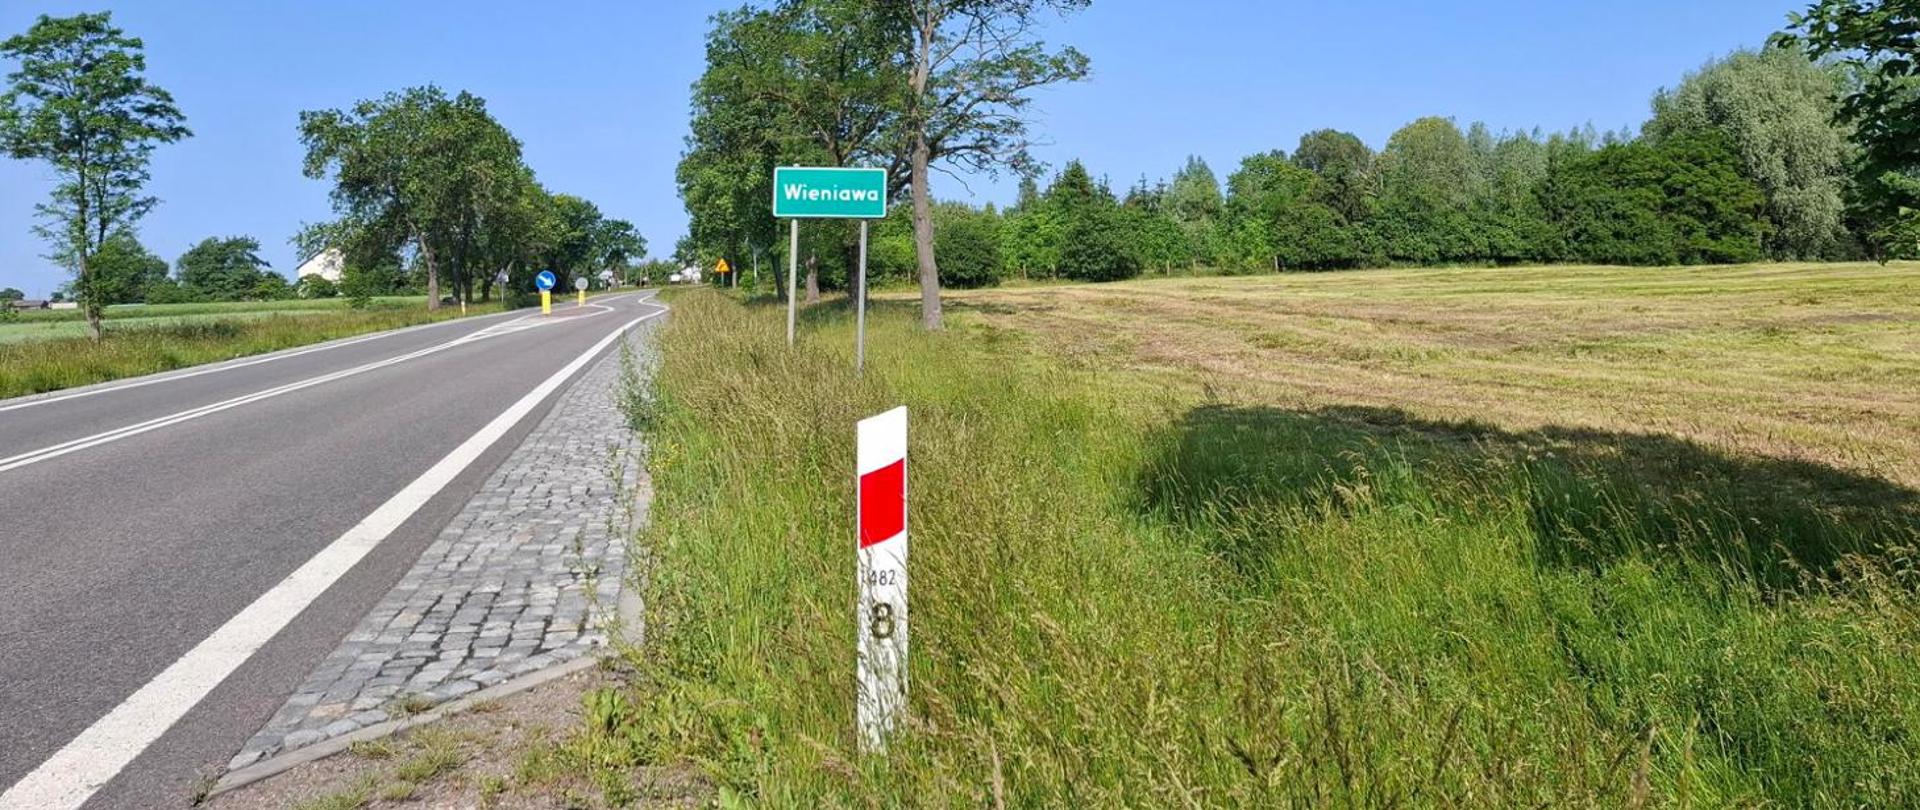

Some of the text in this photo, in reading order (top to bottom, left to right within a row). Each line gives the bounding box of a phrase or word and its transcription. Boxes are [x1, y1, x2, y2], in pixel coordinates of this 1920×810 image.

[784, 183, 879, 201] Wieniawa
[869, 569, 896, 586] 482
[871, 602, 895, 639] 8
